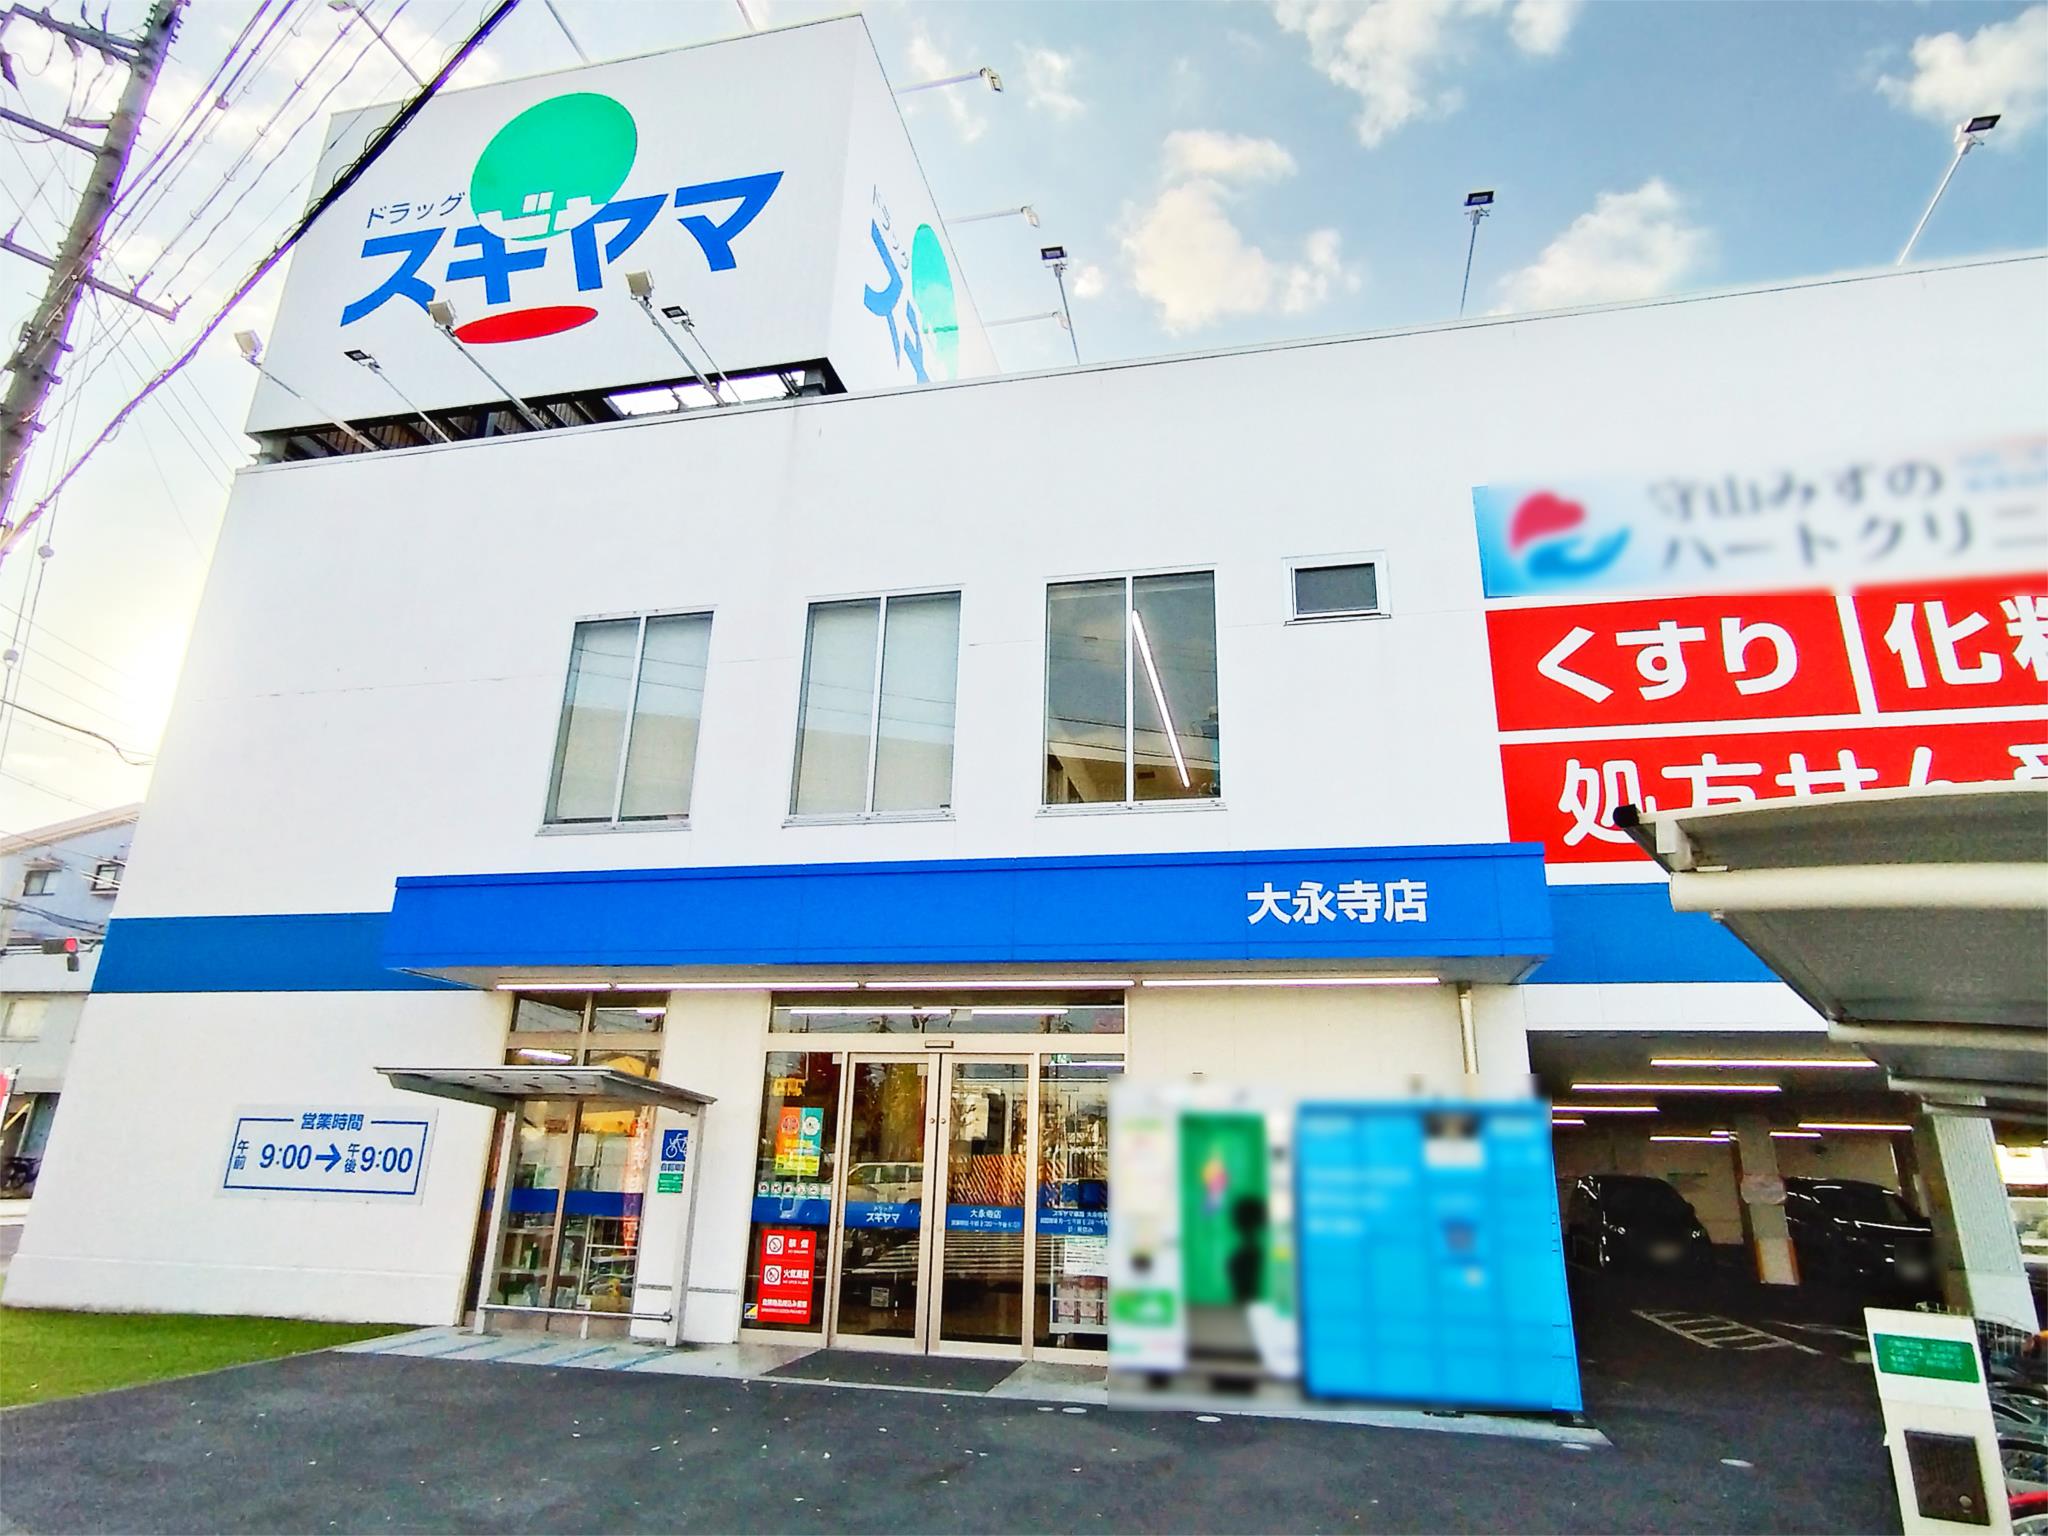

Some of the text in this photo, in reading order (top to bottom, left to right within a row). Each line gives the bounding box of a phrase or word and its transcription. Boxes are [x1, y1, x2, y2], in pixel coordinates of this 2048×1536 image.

[366, 191, 466, 230] ドラッグ
[340, 171, 785, 327] スギヤマ
[1537, 617, 1799, 704] くすり
[1247, 879, 1428, 925] 大永寺店
[301, 1113, 364, 1131] 営業時間
[233, 1140, 413, 1173] 午前 9:00 午後 9:00
